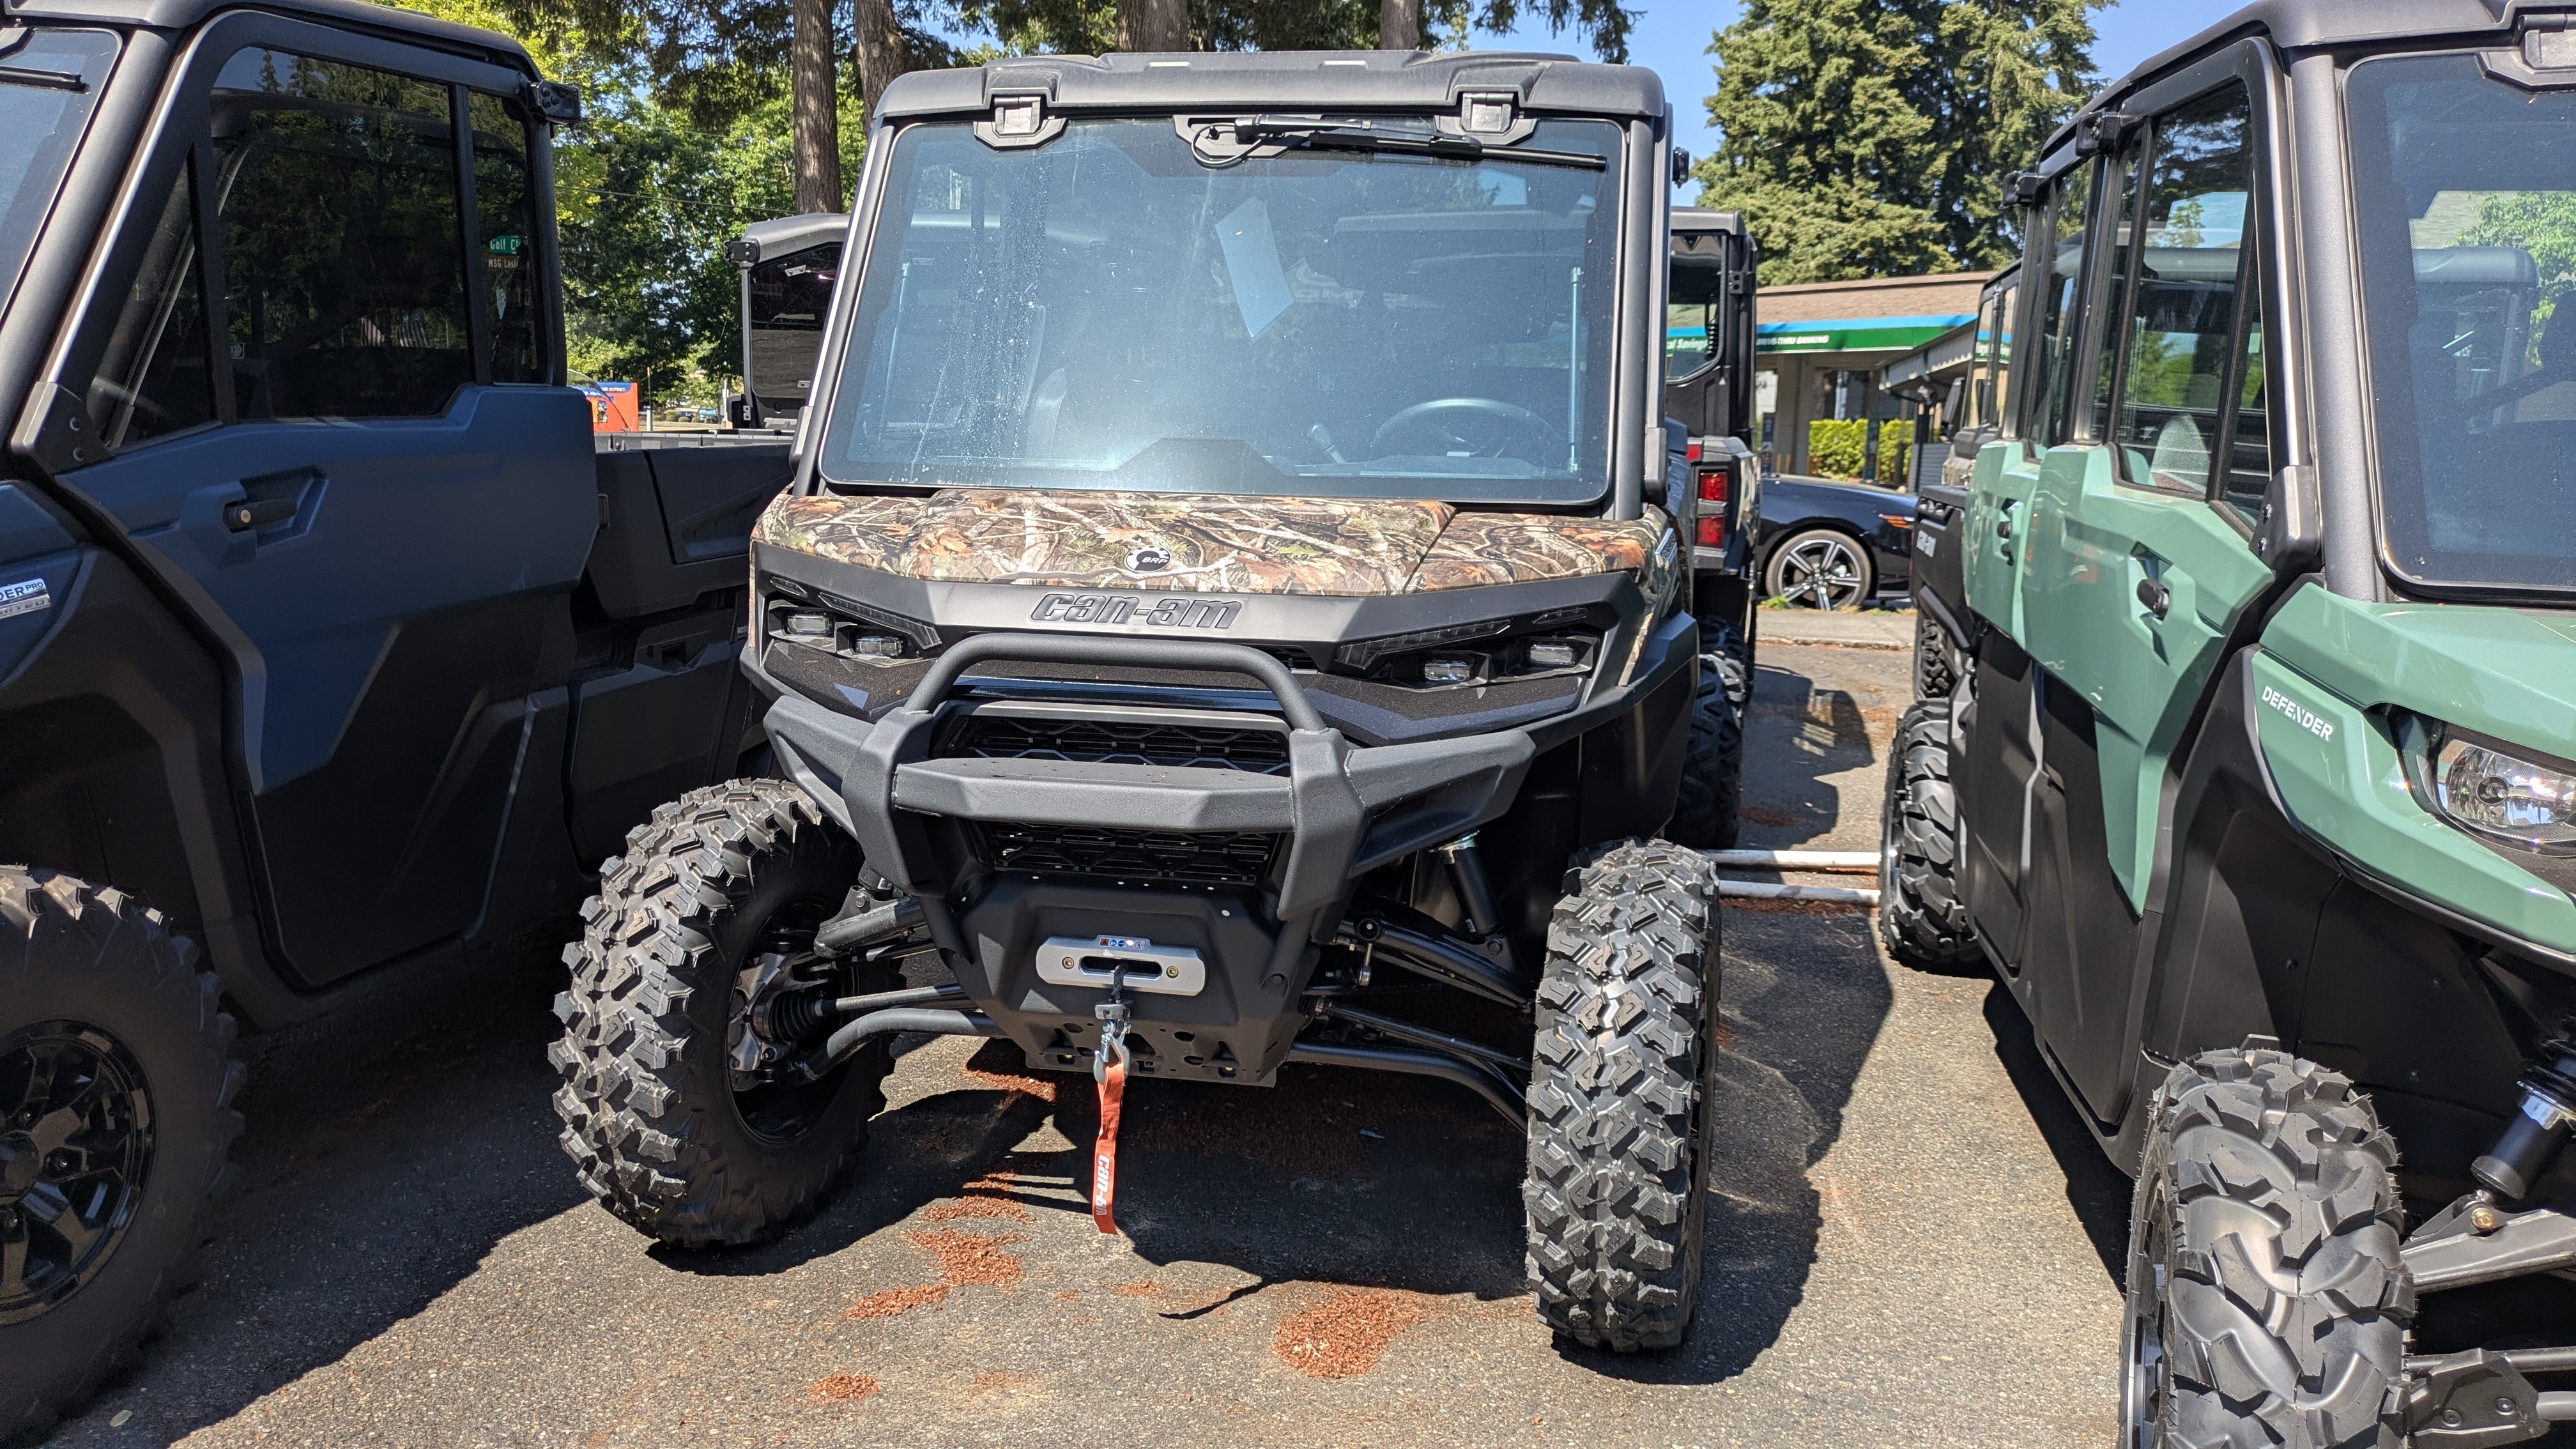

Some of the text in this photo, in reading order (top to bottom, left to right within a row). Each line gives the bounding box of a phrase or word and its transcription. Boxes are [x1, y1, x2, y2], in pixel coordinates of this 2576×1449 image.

[490, 238, 506, 250] Golf
[488, 259, 502, 268] MSG
[26, 582, 43, 591] PRO
[1031, 594, 1242, 629] can-am
[2262, 686, 2333, 742] DEFENDER
